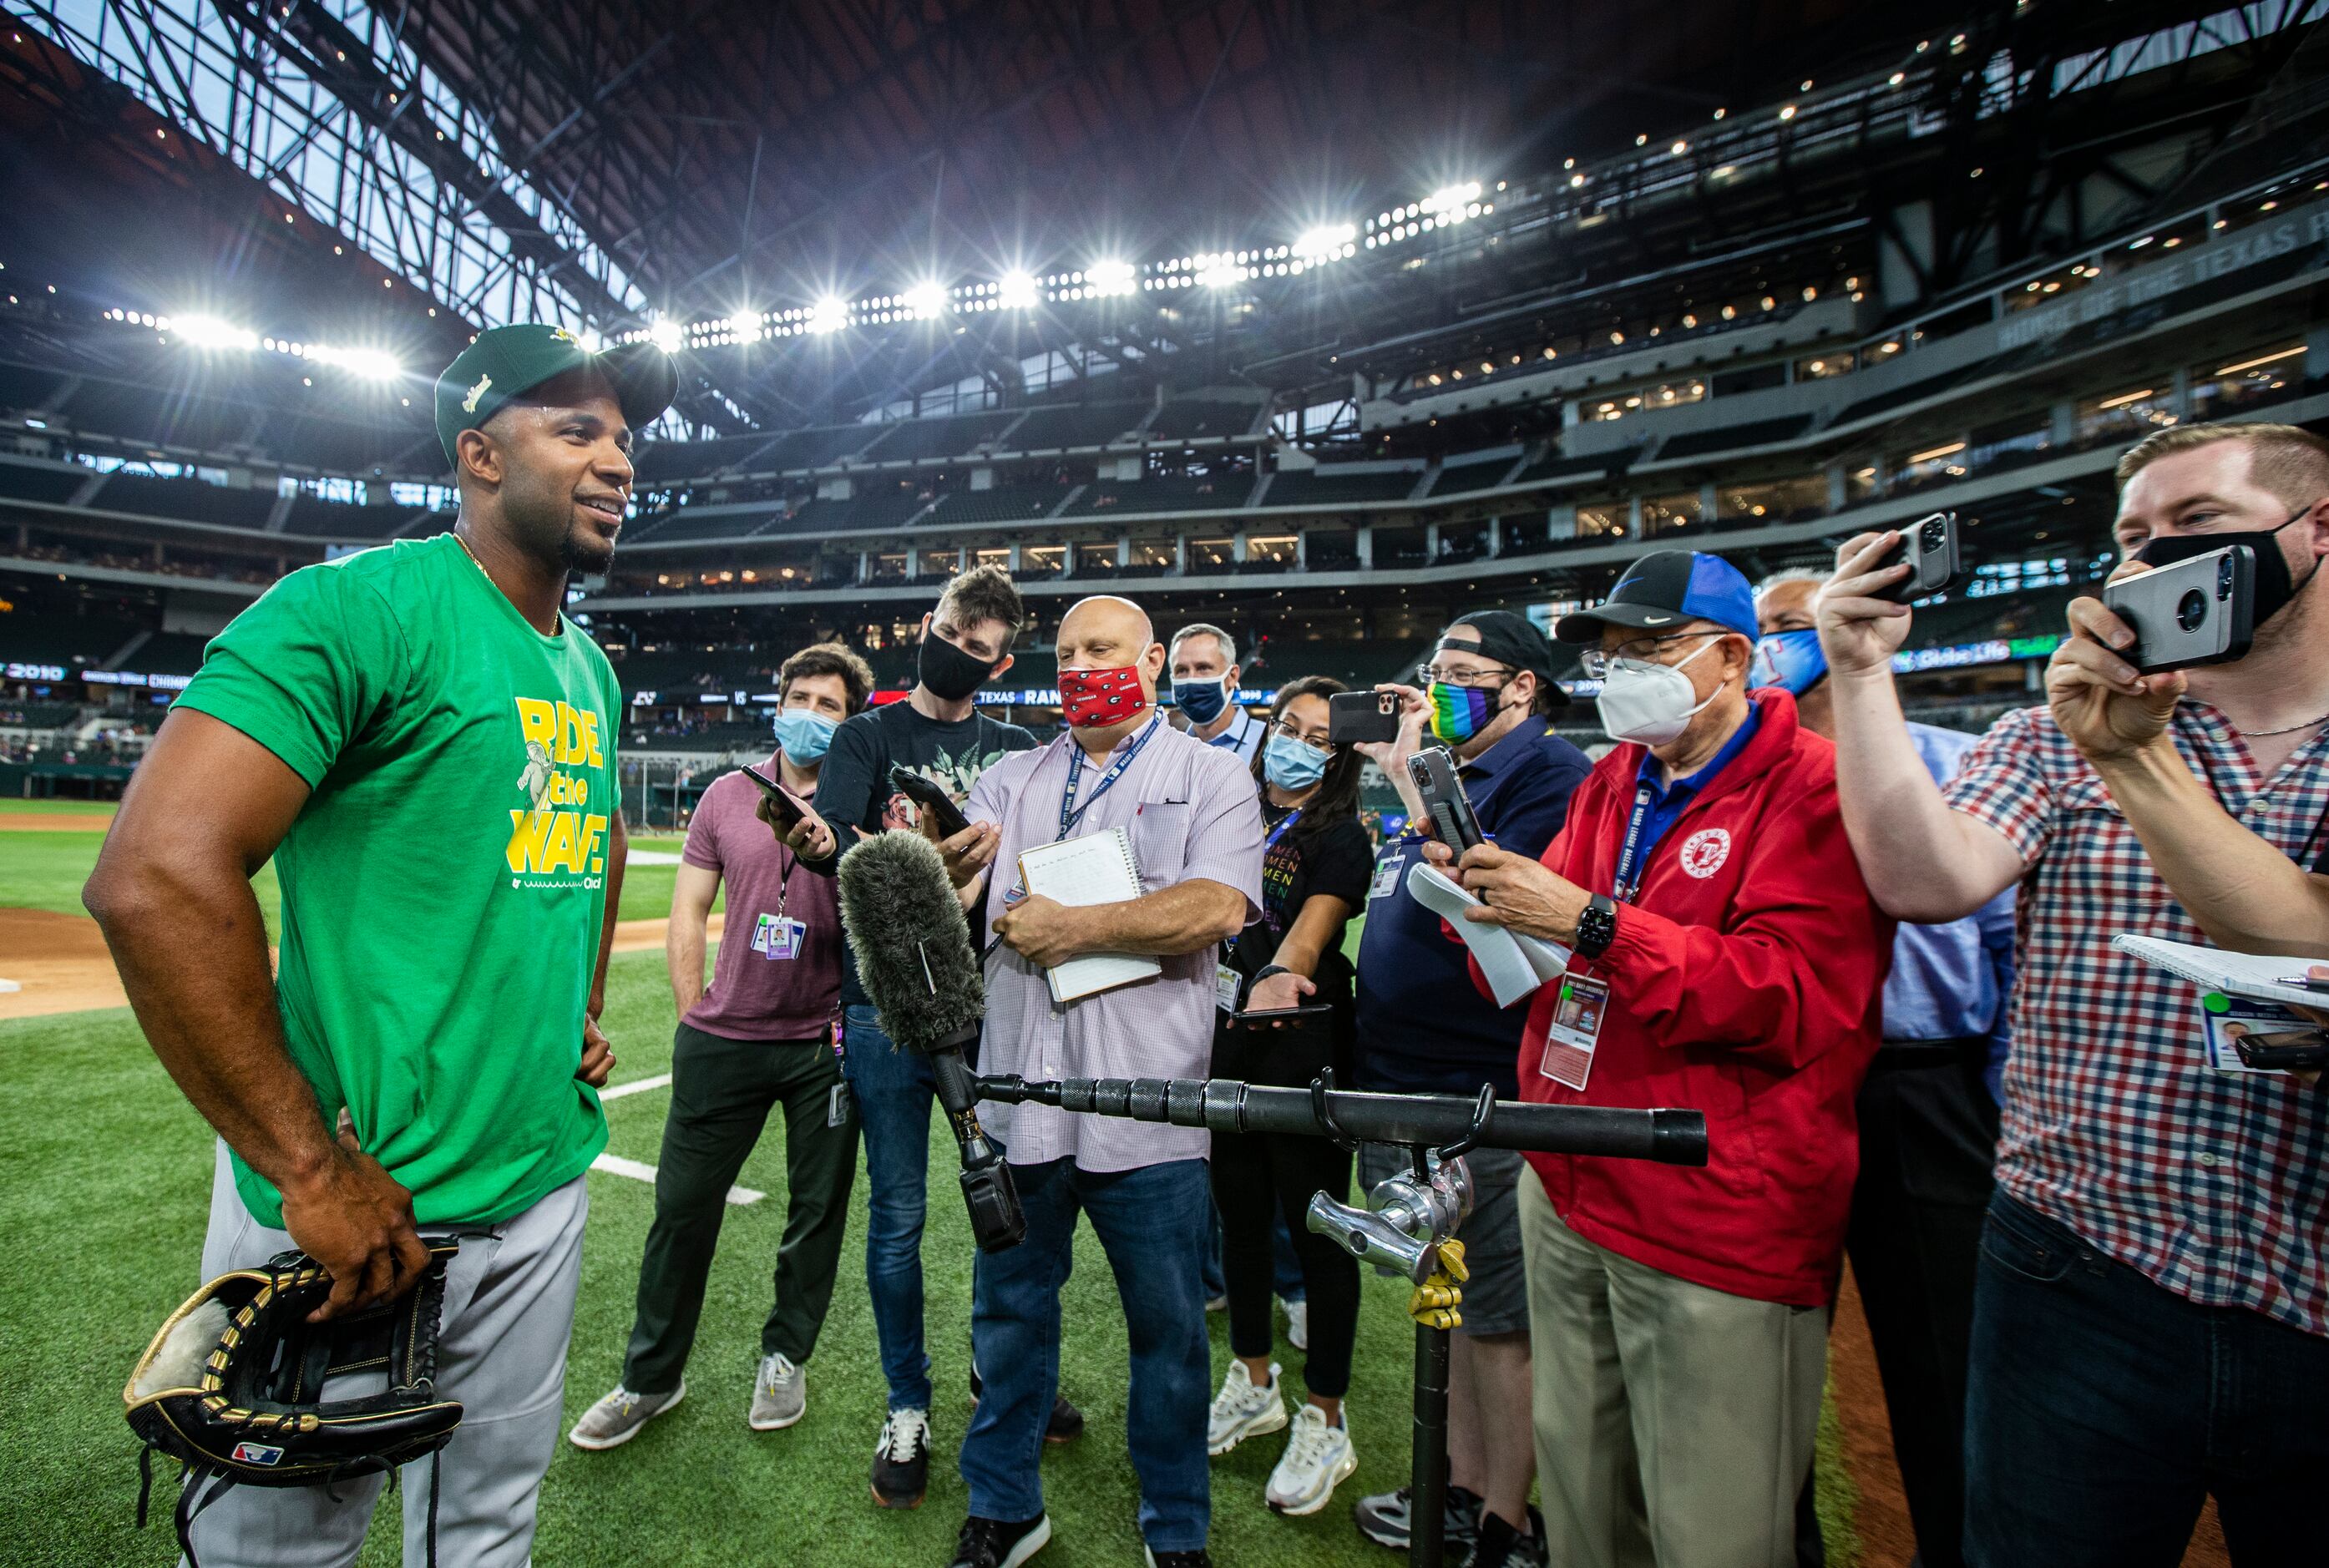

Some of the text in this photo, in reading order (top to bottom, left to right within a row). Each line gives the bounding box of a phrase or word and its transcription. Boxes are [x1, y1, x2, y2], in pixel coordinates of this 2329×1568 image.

[2192, 224, 2299, 283] TEXAS
[8, 663, 66, 681] 2010
[1119, 682, 1138, 691] GEORGIA
[734, 690, 747, 706] VS
[979, 690, 1015, 705] TEXAS
[514, 696, 604, 770] RIDE
[547, 770, 588, 806] the
[505, 809, 608, 874] WAVE
[1620, 807, 1645, 877] MAJOR LEAGUE BASEBALL
